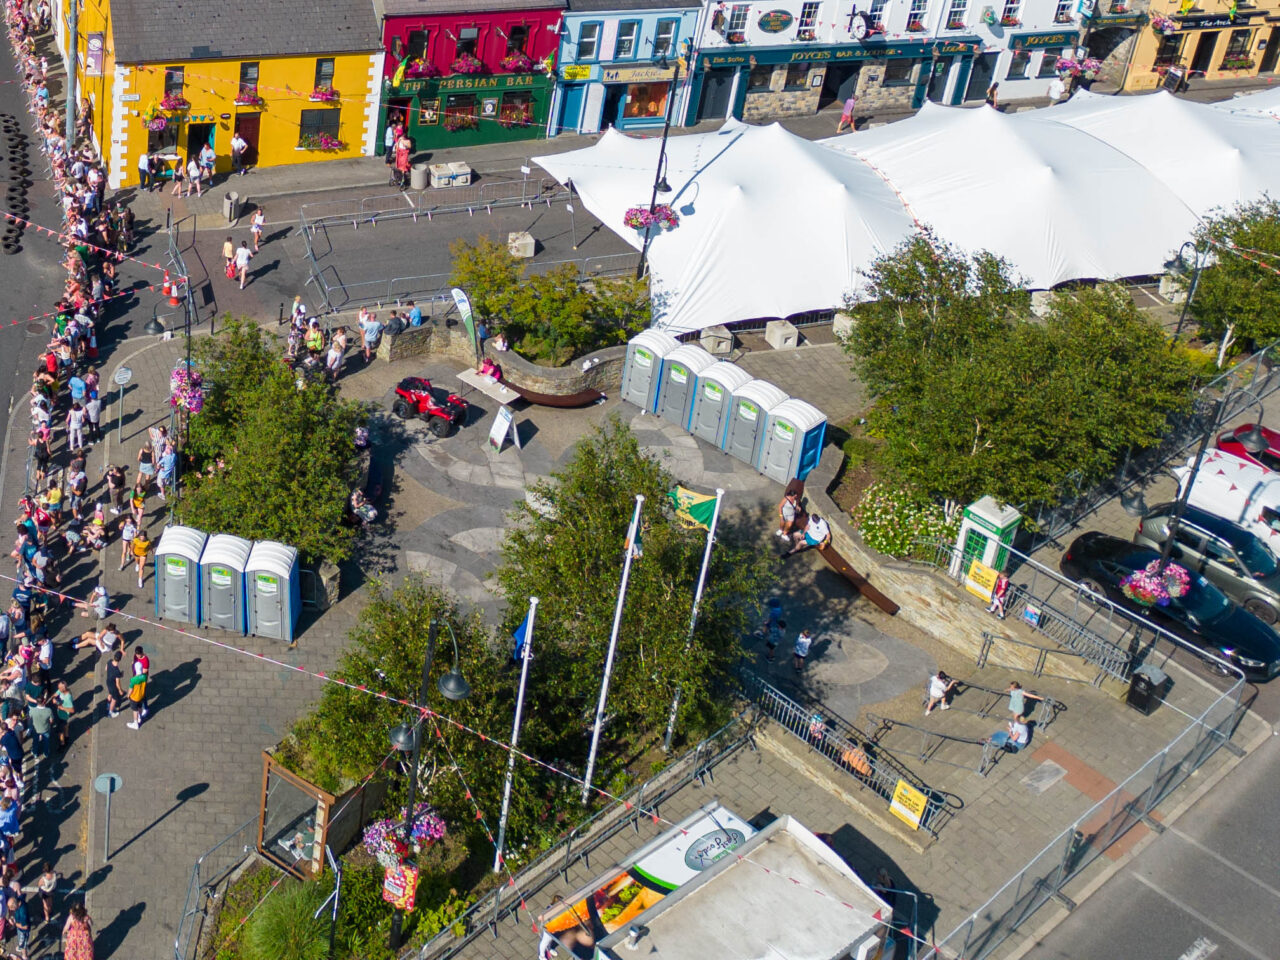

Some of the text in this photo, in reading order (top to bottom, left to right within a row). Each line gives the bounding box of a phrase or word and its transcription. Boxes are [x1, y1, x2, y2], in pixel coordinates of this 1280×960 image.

[835, 50, 853, 58] BAR
[439, 78, 498, 89] PERSIAN
[506, 76, 533, 86] BAR
